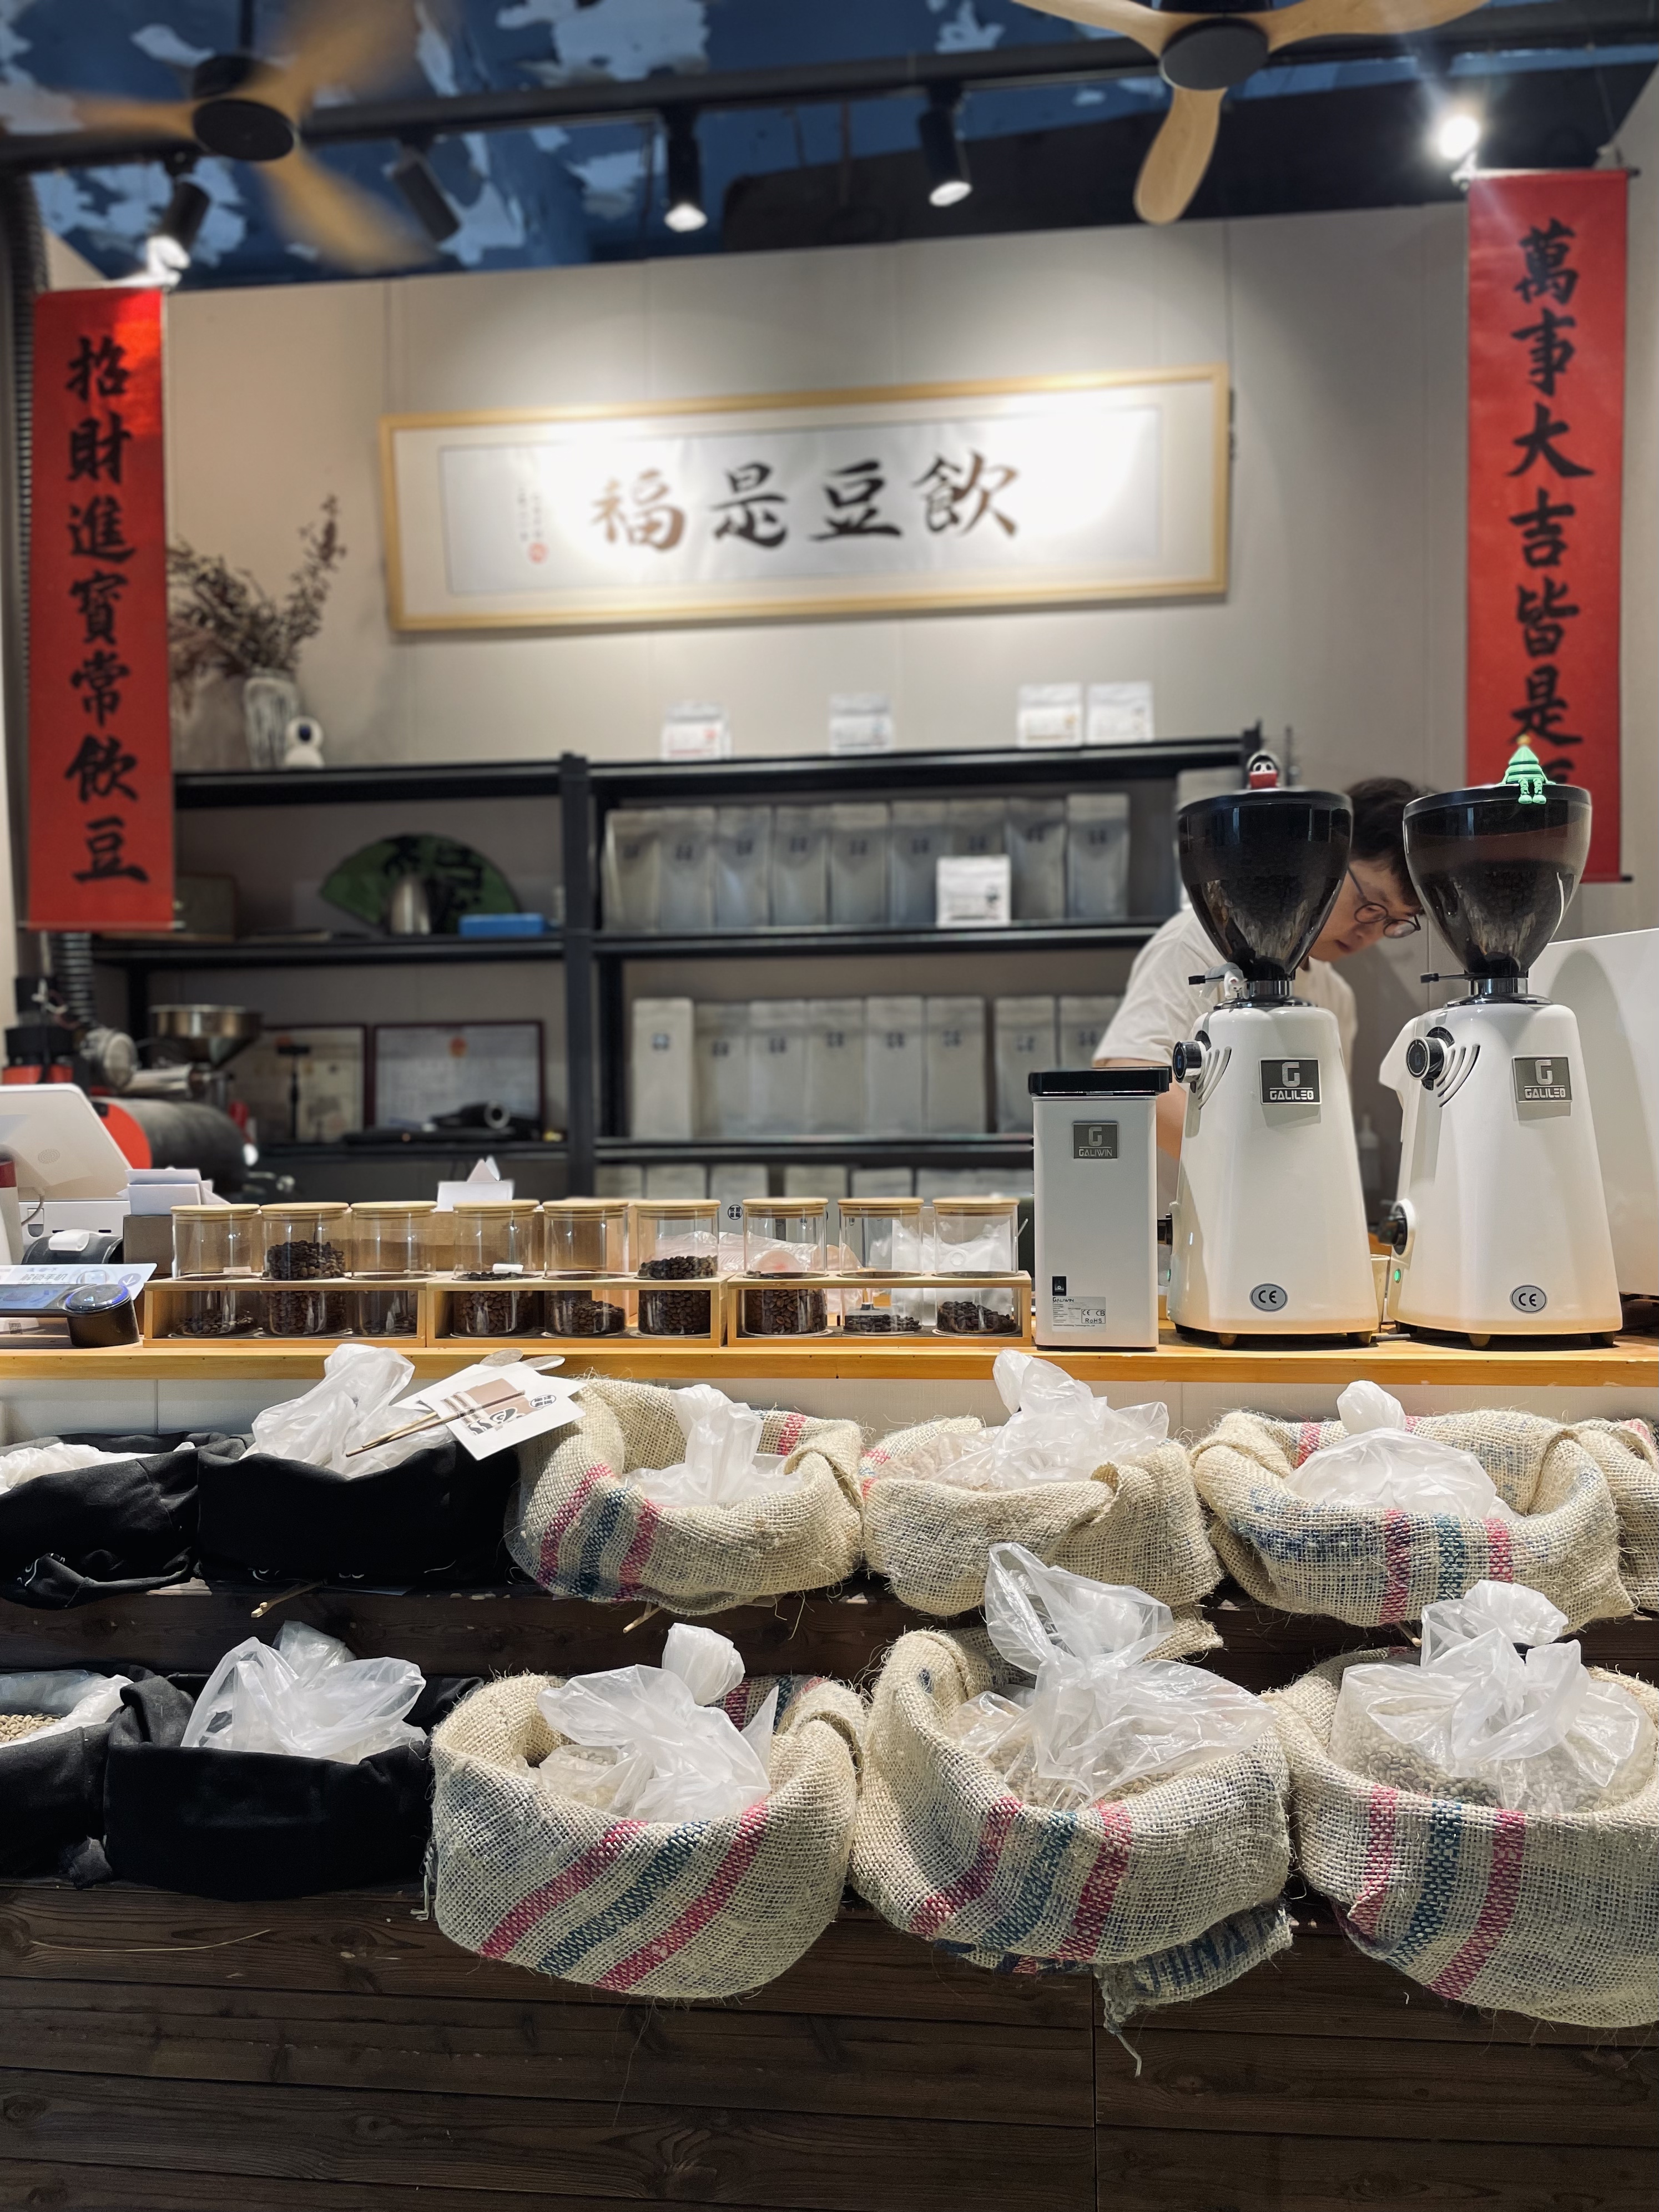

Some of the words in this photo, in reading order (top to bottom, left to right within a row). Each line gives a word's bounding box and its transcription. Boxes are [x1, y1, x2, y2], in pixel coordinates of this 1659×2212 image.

[64, 337, 149, 883] 招財進寶常飲豆
[1282, 1062, 1300, 1087] G
[1535, 1059, 1553, 1085] G
[1269, 1090, 1314, 1100] GALILEO
[1525, 1088, 1566, 1099] GALILEO
[1088, 1127, 1102, 1147] G
[1258, 1290, 1277, 1304] CE
[1519, 1293, 1536, 1307] CE
